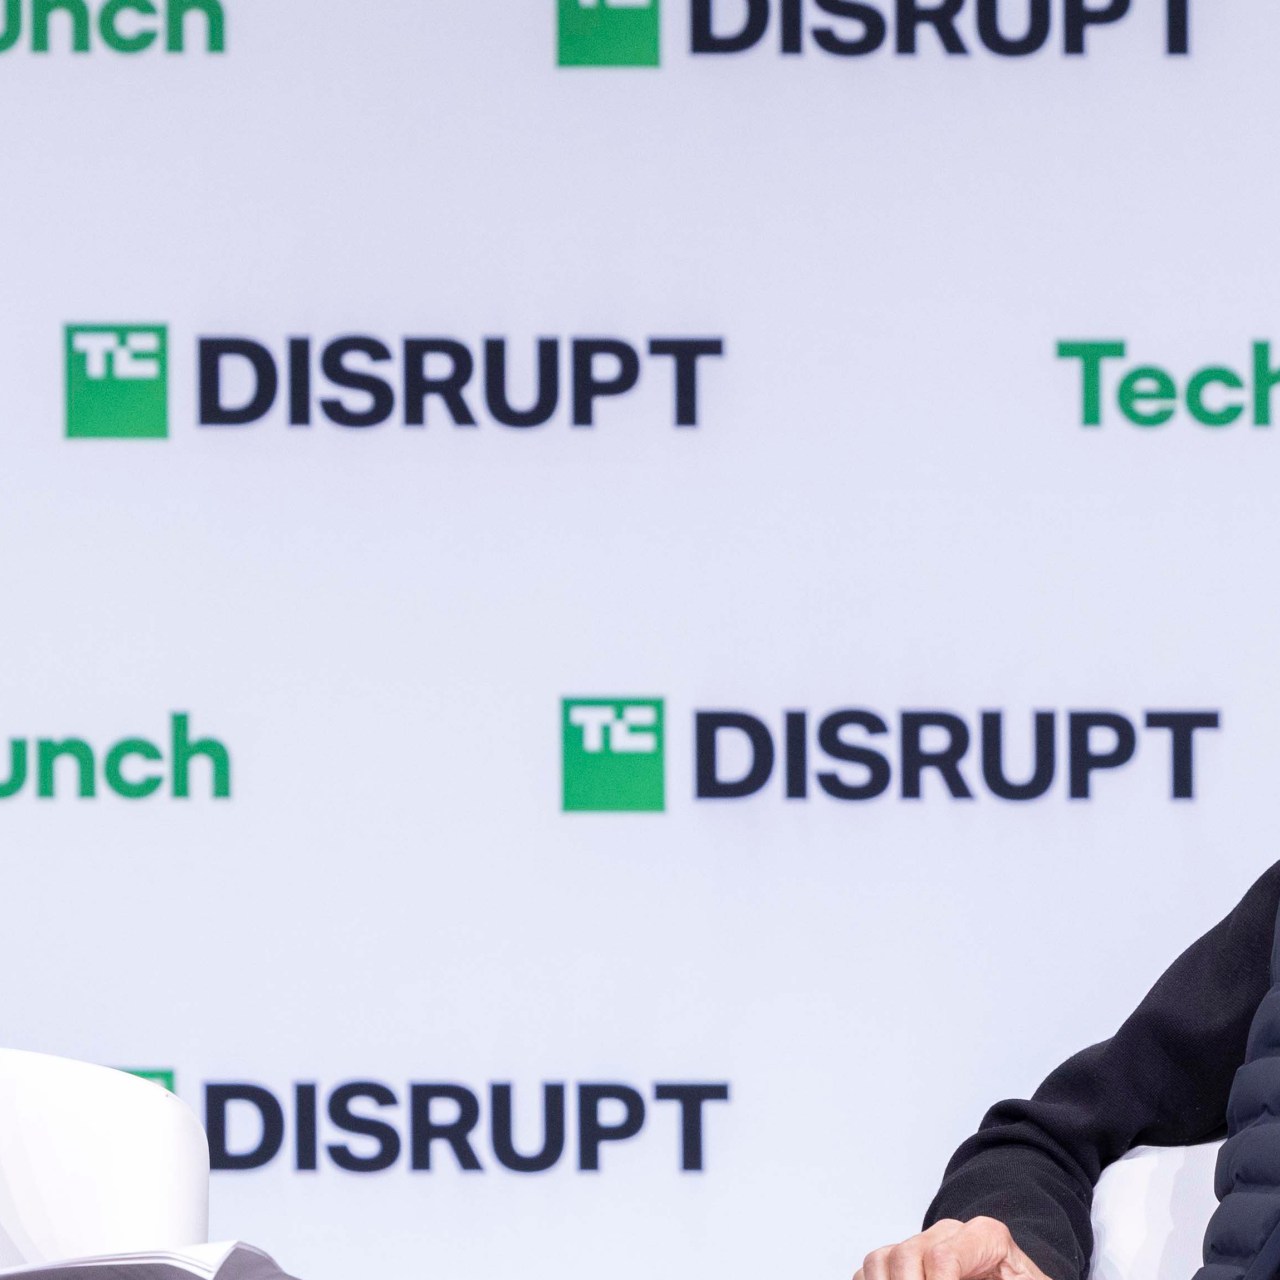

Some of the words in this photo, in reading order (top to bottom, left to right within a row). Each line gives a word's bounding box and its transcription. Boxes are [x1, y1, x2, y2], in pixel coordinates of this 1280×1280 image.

[197, 336, 723, 428] DISRUPT
[694, 709, 1220, 801] DISRUPT
[204, 1082, 729, 1173] DISRUPT
